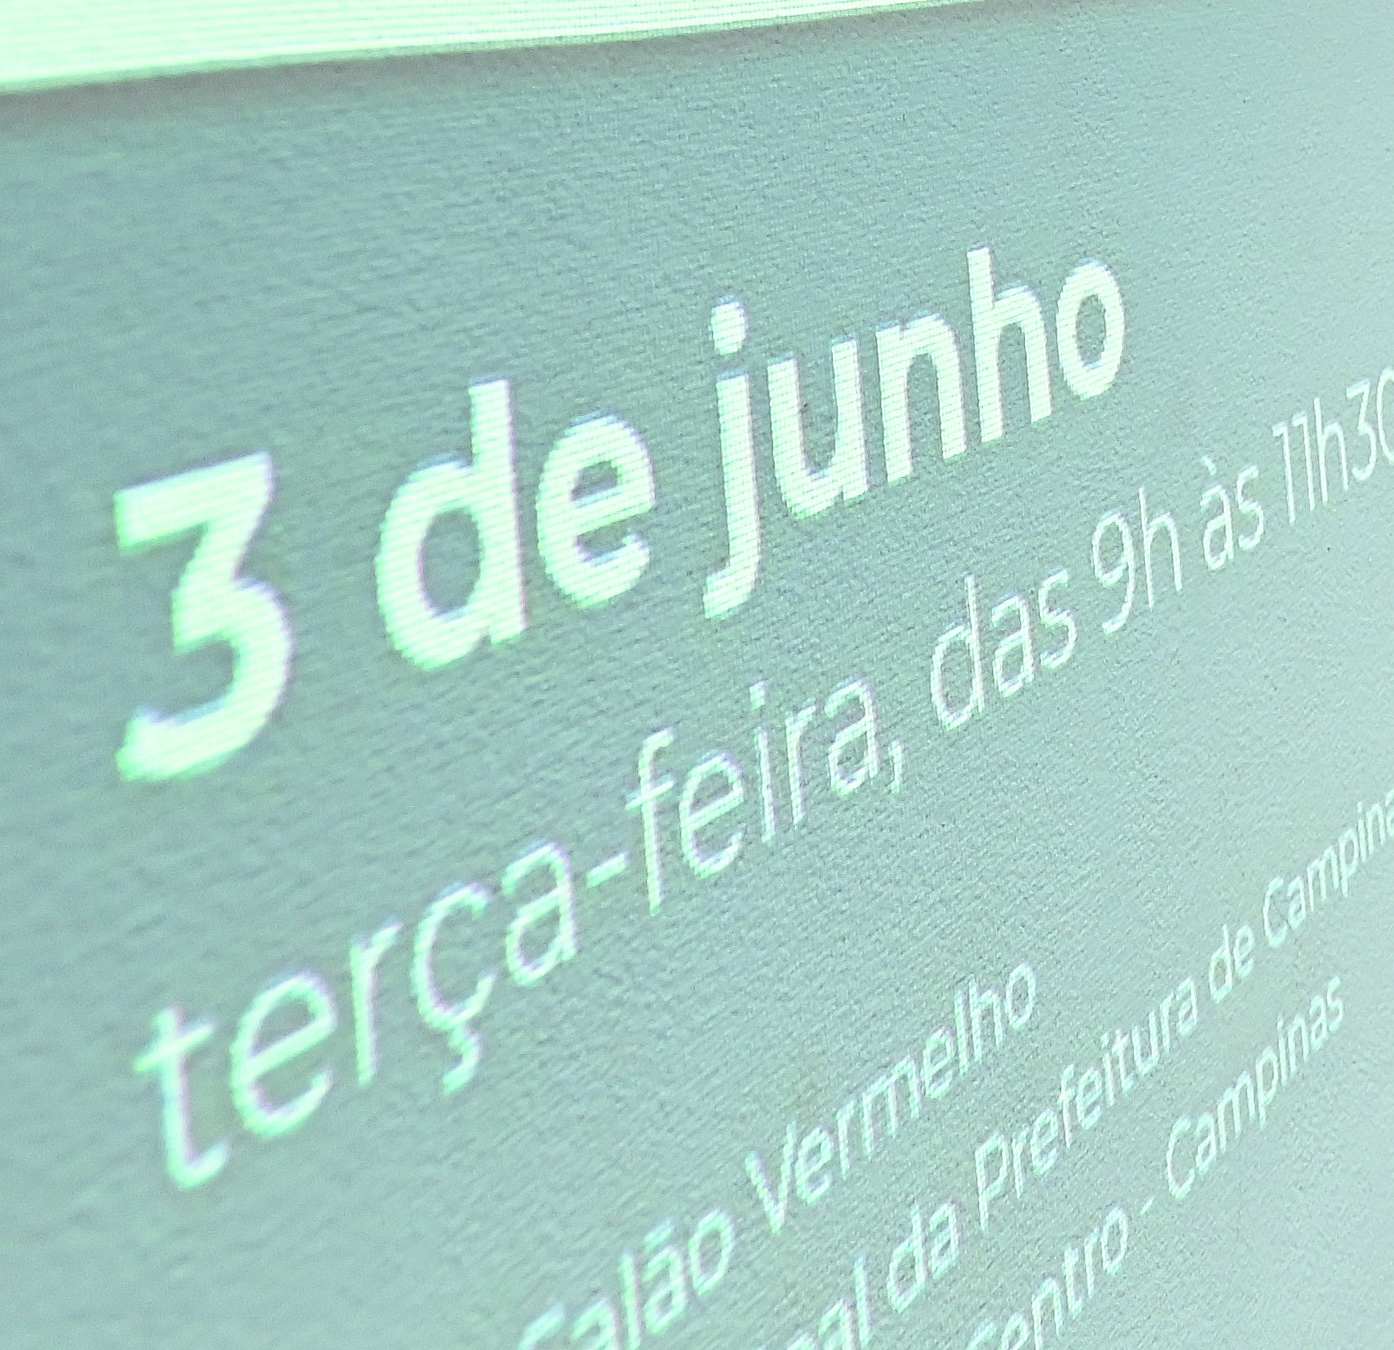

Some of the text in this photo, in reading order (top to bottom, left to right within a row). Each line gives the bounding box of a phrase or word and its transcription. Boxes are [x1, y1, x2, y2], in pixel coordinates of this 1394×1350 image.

[113, 246, 1126, 783] 3 de junho
[134, 677, 904, 1189] terça-feira,
[930, 573, 1079, 731] das
[1091, 487, 1184, 636] 9h
[1199, 455, 1266, 572] às
[744, 962, 1036, 1236] Vermelho
[886, 1200, 960, 1314] da
[974, 976, 1198, 1232] Prefeitura
[1208, 924, 1256, 1004] de
[1166, 975, 1346, 1200] Campinas
